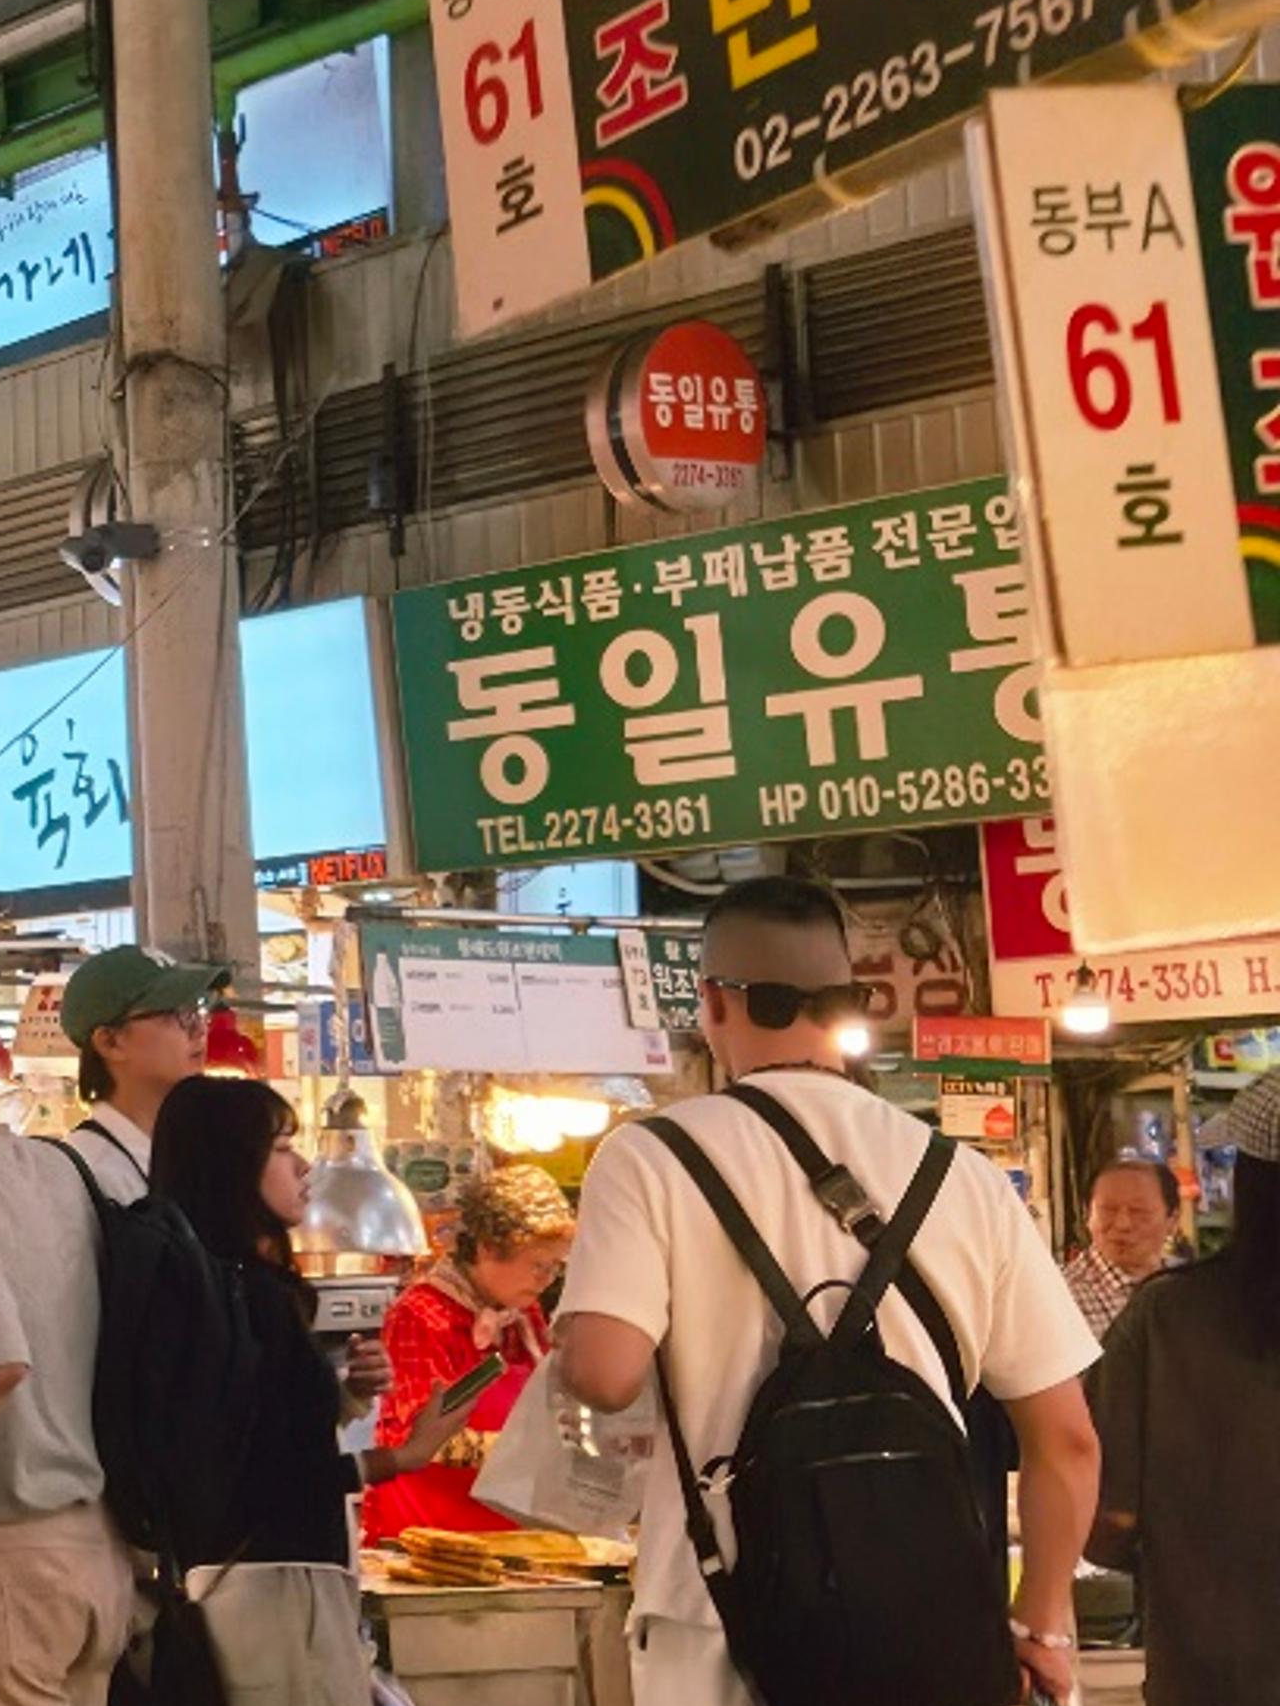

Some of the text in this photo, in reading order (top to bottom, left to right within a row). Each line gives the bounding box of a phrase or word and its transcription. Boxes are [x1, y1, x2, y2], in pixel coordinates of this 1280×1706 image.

[463, 20, 546, 147] 61
[496, 159, 544, 236] 호
[1029, 179, 1186, 259] 동부A
[646, 371, 760, 435] 동일유통
[1065, 299, 1183, 434] 61
[1115, 461, 1184, 551] 호
[12, 717, 134, 871] 육회
[477, 793, 712, 857] TEL.2274-3361
[759, 785, 808, 829] HP
